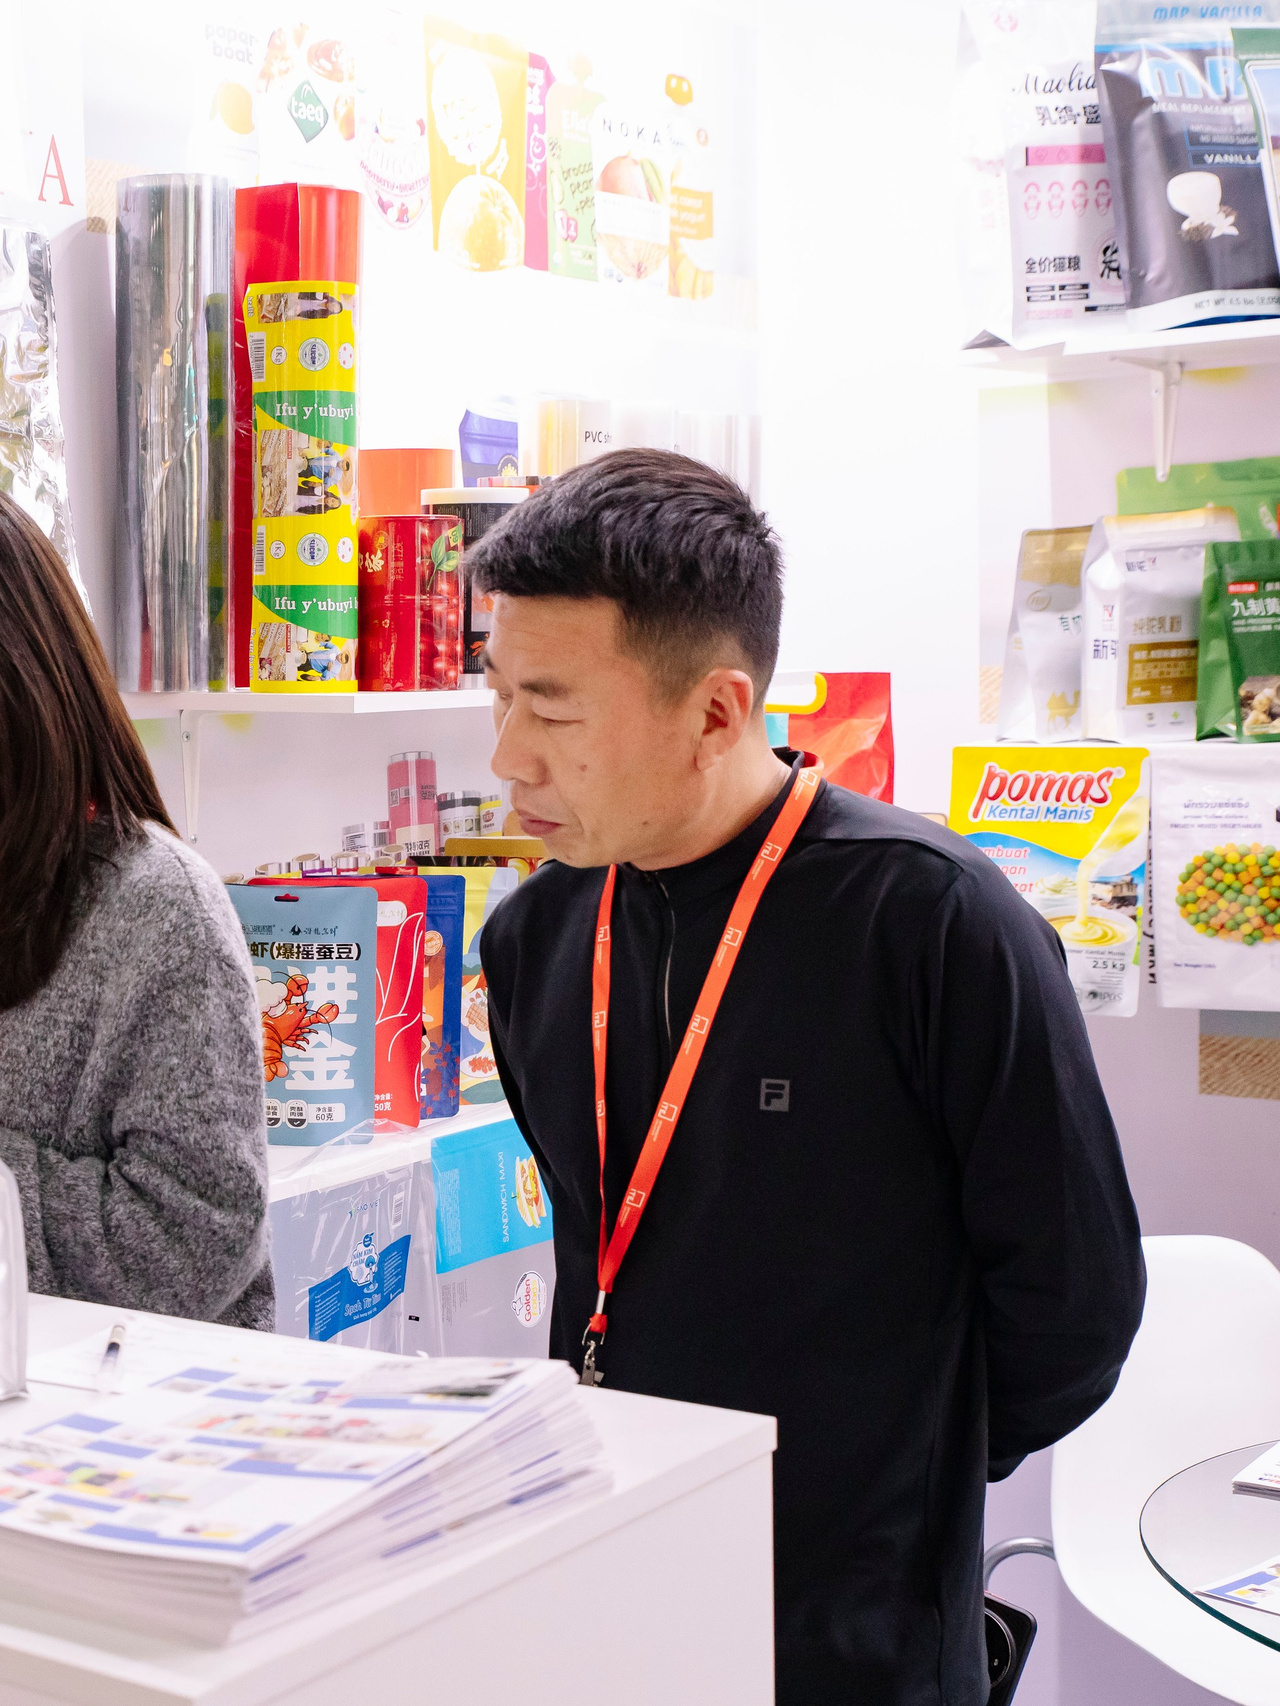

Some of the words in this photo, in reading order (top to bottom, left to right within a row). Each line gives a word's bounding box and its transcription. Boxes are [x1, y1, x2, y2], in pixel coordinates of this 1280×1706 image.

[205, 22, 258, 46] paper
[213, 40, 253, 64] boat
[290, 96, 325, 127] taeq
[603, 118, 661, 145] NOKA
[38, 134, 74, 206] A
[276, 403, 297, 416] Ifu
[584, 430, 603, 443] PVC
[275, 597, 296, 610] Ifu
[972, 765, 1113, 818] pomas
[988, 805, 1040, 820] Kental
[1043, 806, 1092, 821] Manis
[983, 847, 1028, 859] mbuat
[1004, 865, 1026, 877] gan
[1013, 883, 1033, 893] zat
[249, 942, 362, 961] 虾(爆摇蚕豆)
[1092, 960, 1108, 969] 2.5
[1111, 960, 1125, 971] kg
[282, 1030, 357, 1090] 金
[316, 1113, 334, 1122] 60克
[498, 1152, 506, 1180] MAXI
[501, 1184, 510, 1243] SANDWICH
[524, 1279, 532, 1322] Golden
